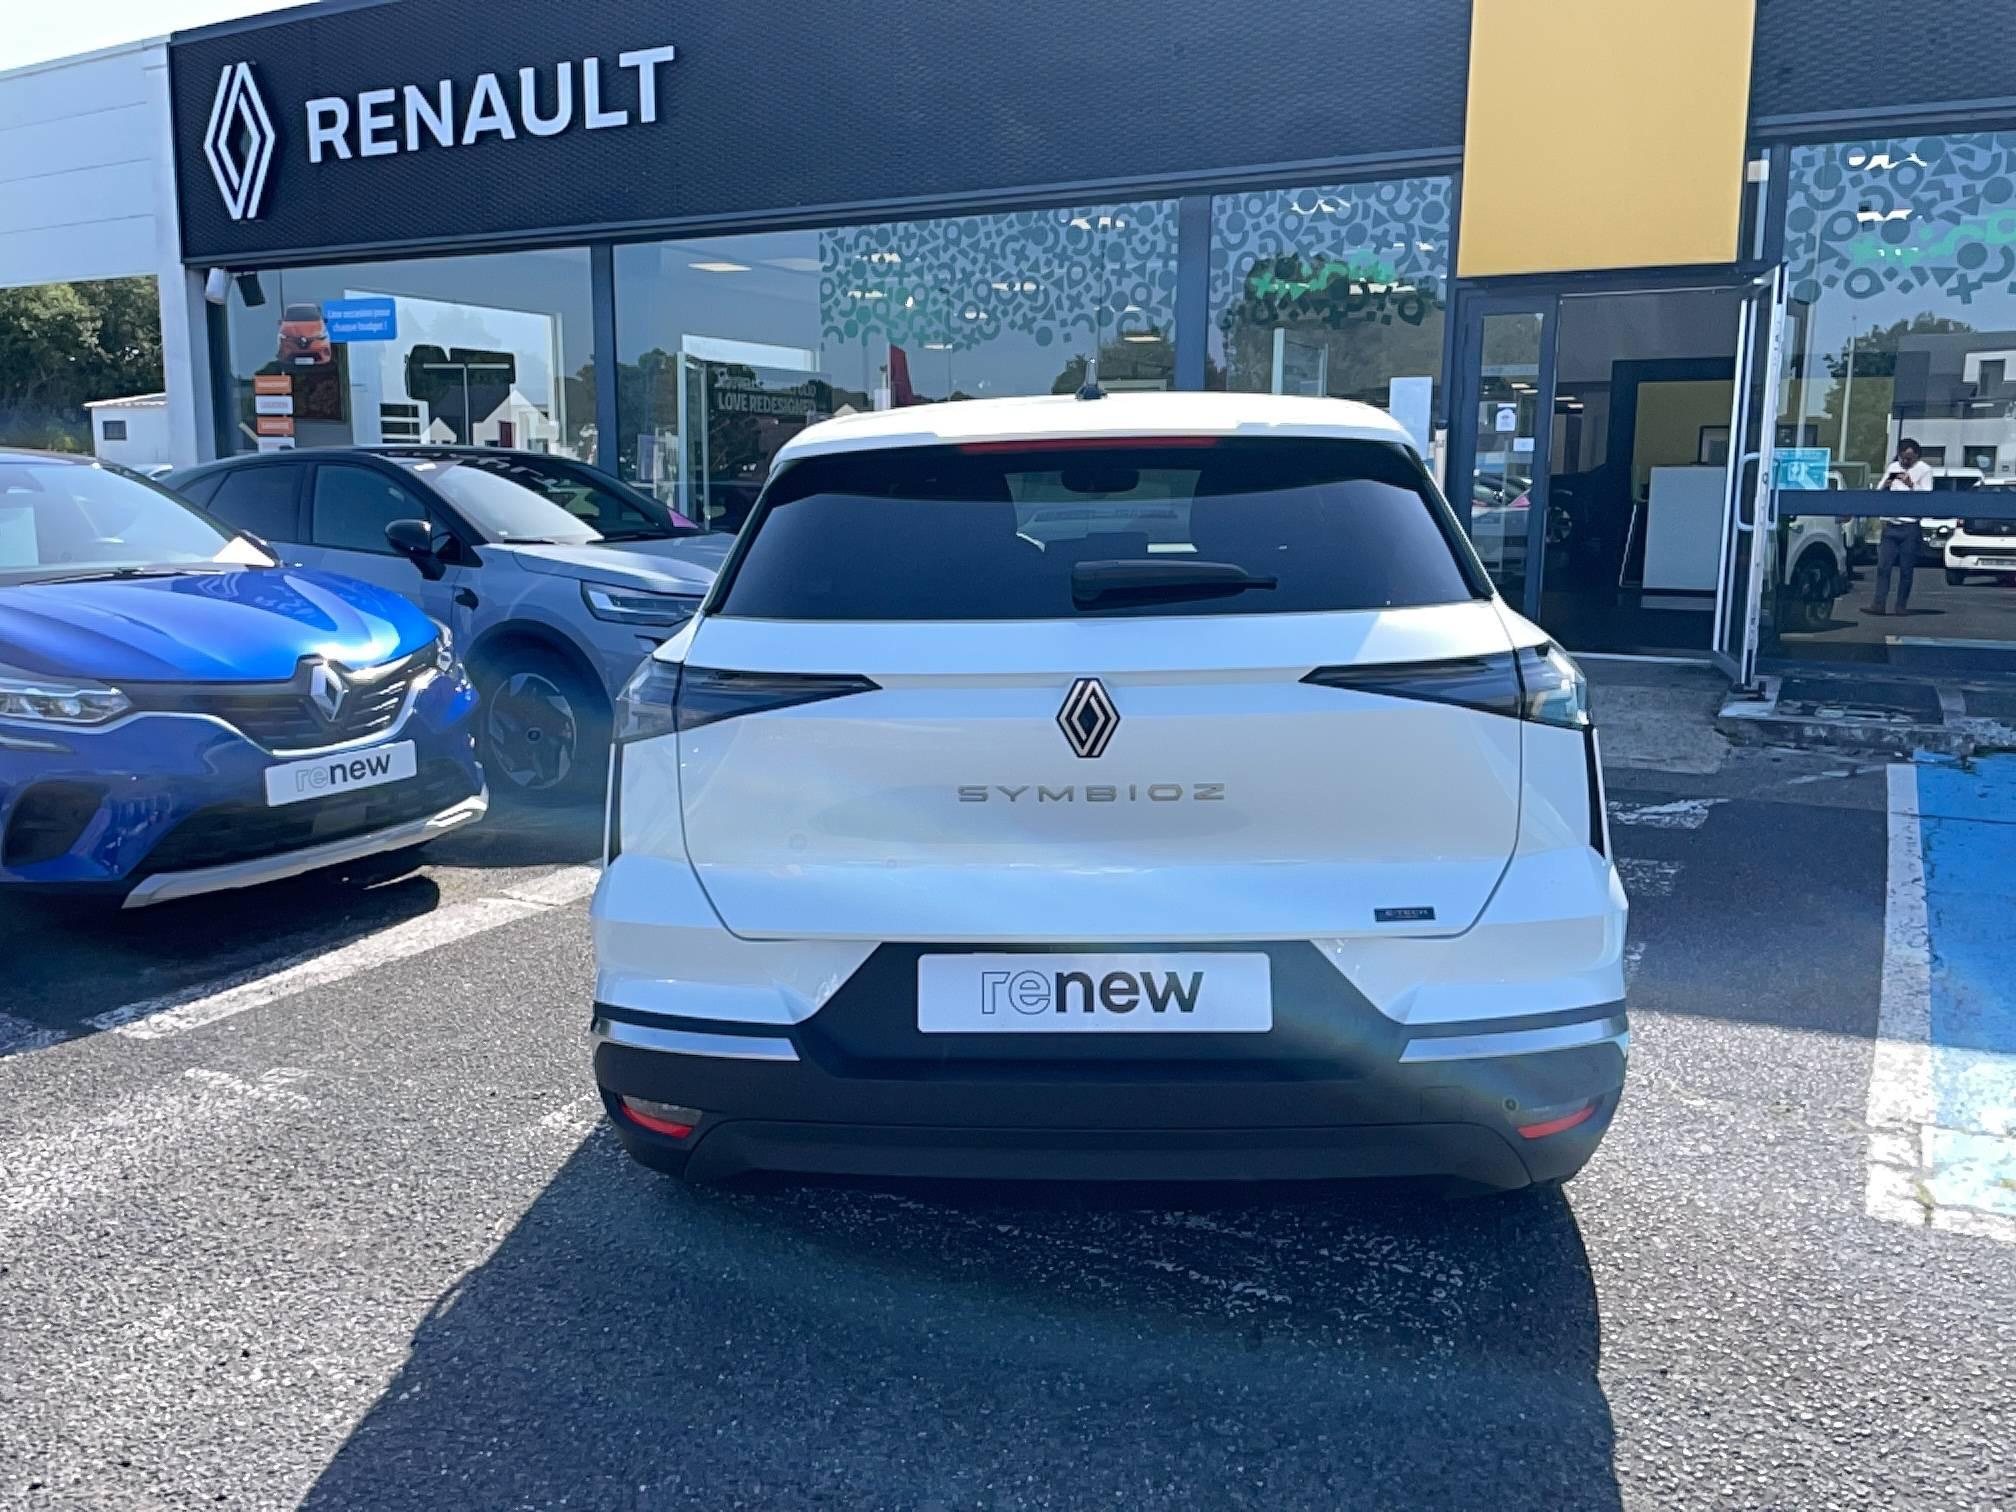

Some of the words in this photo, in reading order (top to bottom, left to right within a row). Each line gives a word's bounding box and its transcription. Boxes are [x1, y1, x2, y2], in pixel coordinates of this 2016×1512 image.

[306, 45, 675, 163] RENAULT
[718, 391, 748, 411] LOVE
[296, 754, 391, 793] renew
[958, 783, 1225, 802] SYMBIOZ
[981, 970, 1205, 1015] renew
